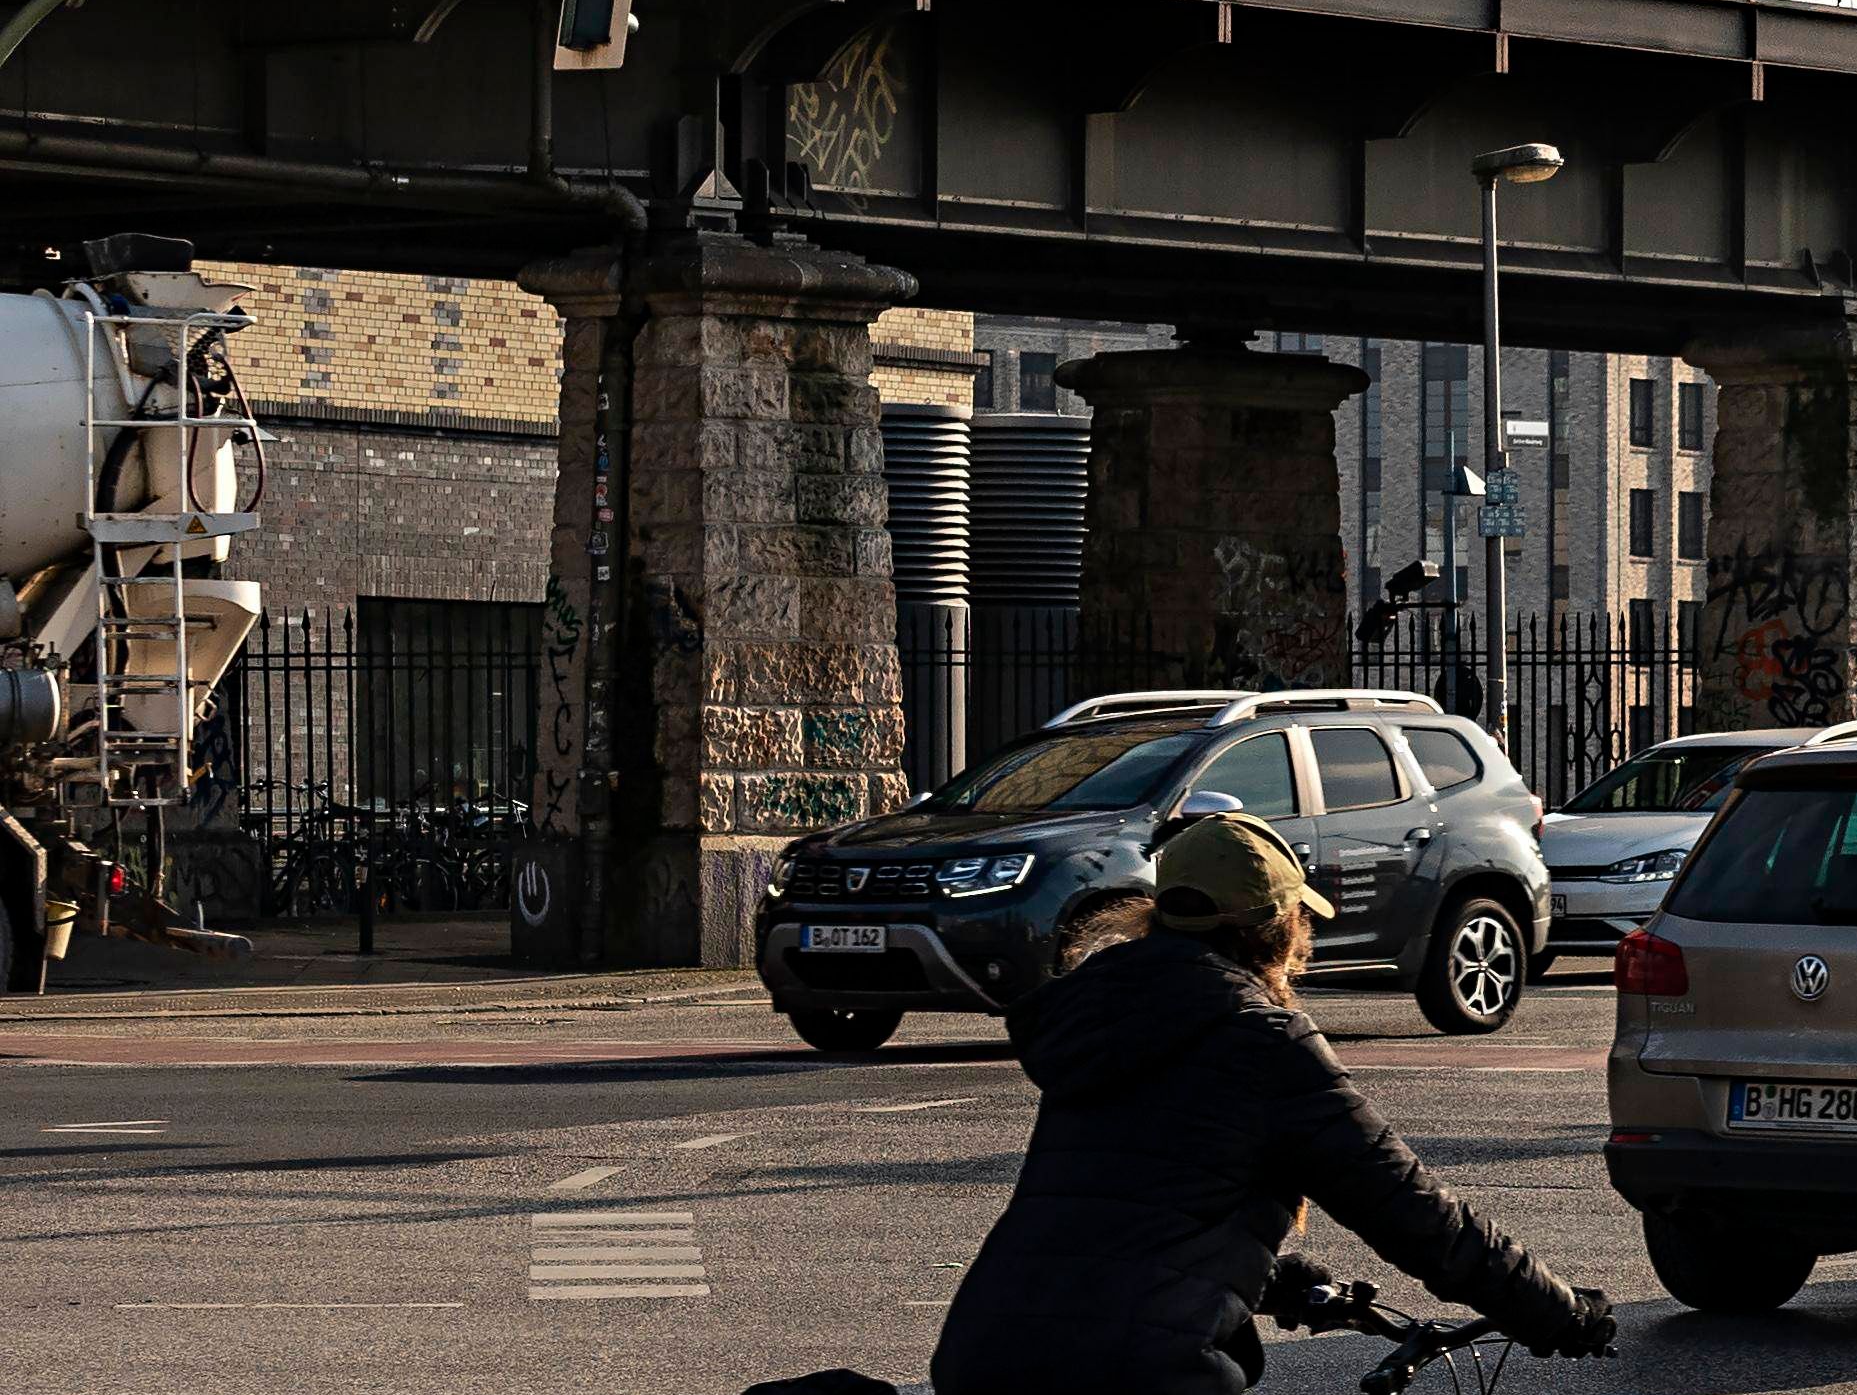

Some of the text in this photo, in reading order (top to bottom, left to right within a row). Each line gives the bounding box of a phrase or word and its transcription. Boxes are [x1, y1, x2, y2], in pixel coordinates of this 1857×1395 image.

[812, 927, 823, 946] B
[851, 928, 880, 947] 162
[1744, 1086, 1762, 1117] B
[1778, 1088, 1813, 1120] HG
